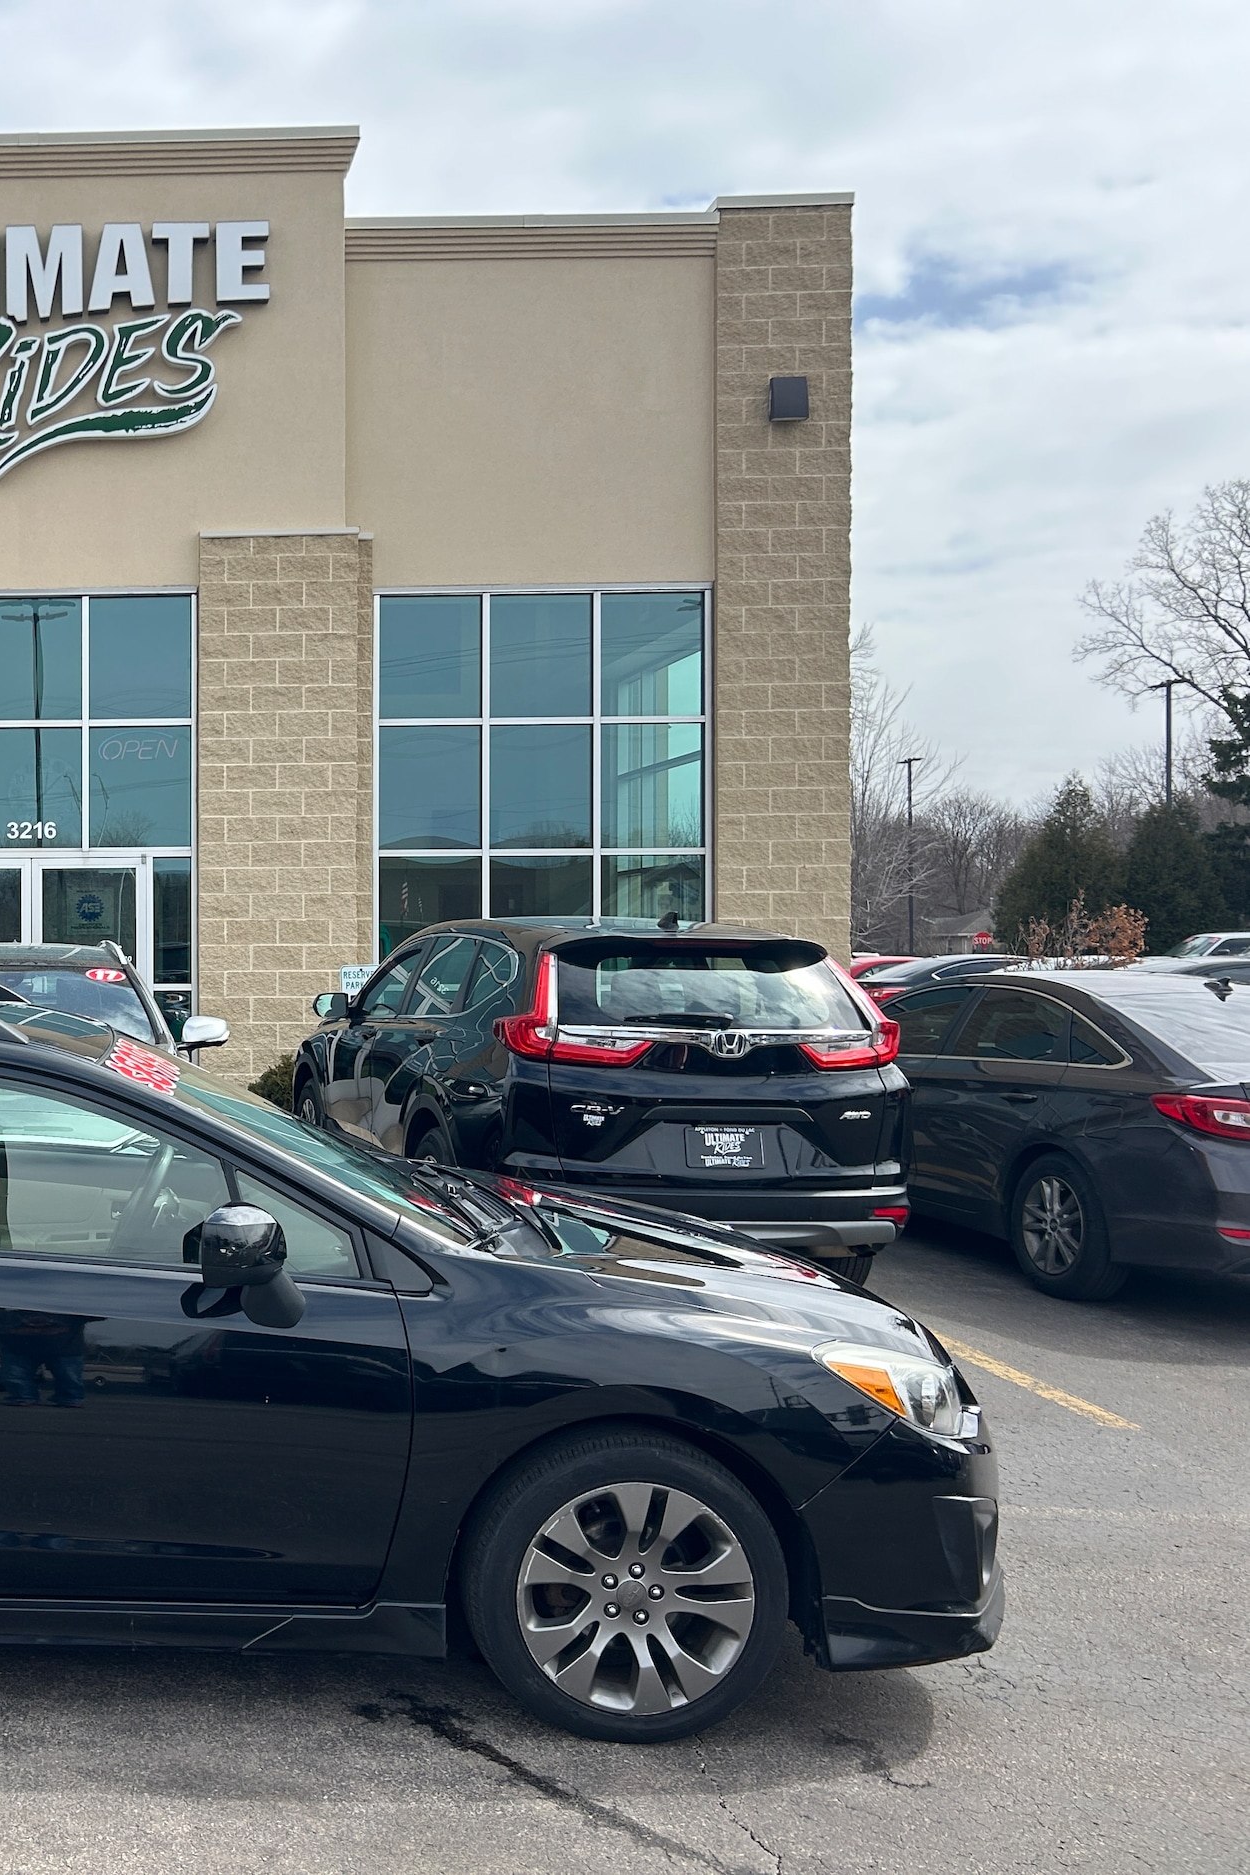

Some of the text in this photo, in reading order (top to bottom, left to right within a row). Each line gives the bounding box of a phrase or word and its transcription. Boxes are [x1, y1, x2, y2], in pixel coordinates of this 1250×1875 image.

[102, 739, 179, 760] OPEN
[6, 821, 57, 840] 3216
[80, 902, 101, 913] ASE
[973, 936, 992, 945] STOP
[343, 971, 375, 979] RESERVE
[345, 981, 364, 990] PARK
[570, 1104, 625, 1115] CR-V
[840, 1110, 871, 1120] AWD
[705, 1132, 745, 1146] ULTIMATE
